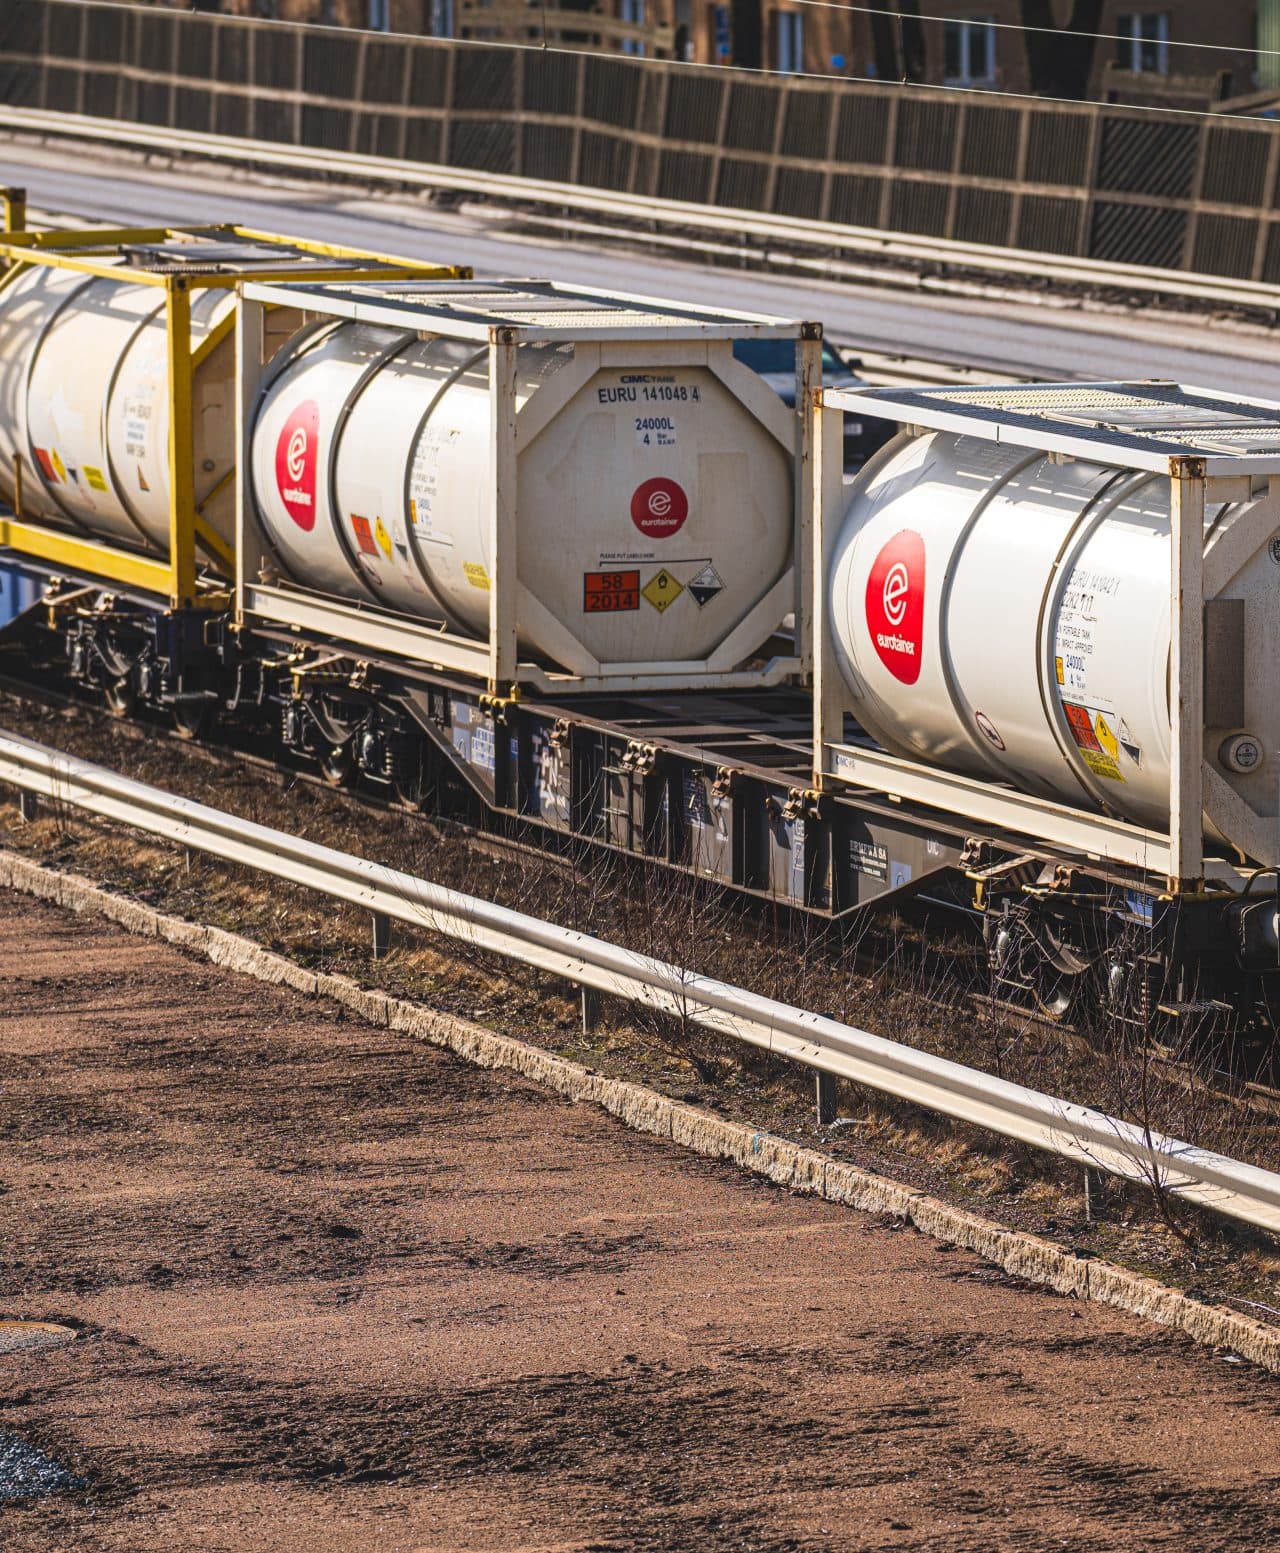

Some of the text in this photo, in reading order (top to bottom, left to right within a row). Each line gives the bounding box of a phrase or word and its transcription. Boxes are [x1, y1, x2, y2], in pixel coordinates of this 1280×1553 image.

[598, 386, 699, 403] EURU 141048 4
[636, 417, 674, 430] 24000L
[643, 433, 650, 445] 4
[641, 518, 678, 527] eurotainer
[602, 575, 623, 589] 58
[591, 592, 633, 609] 2014
[877, 632, 915, 656] eurotainer
